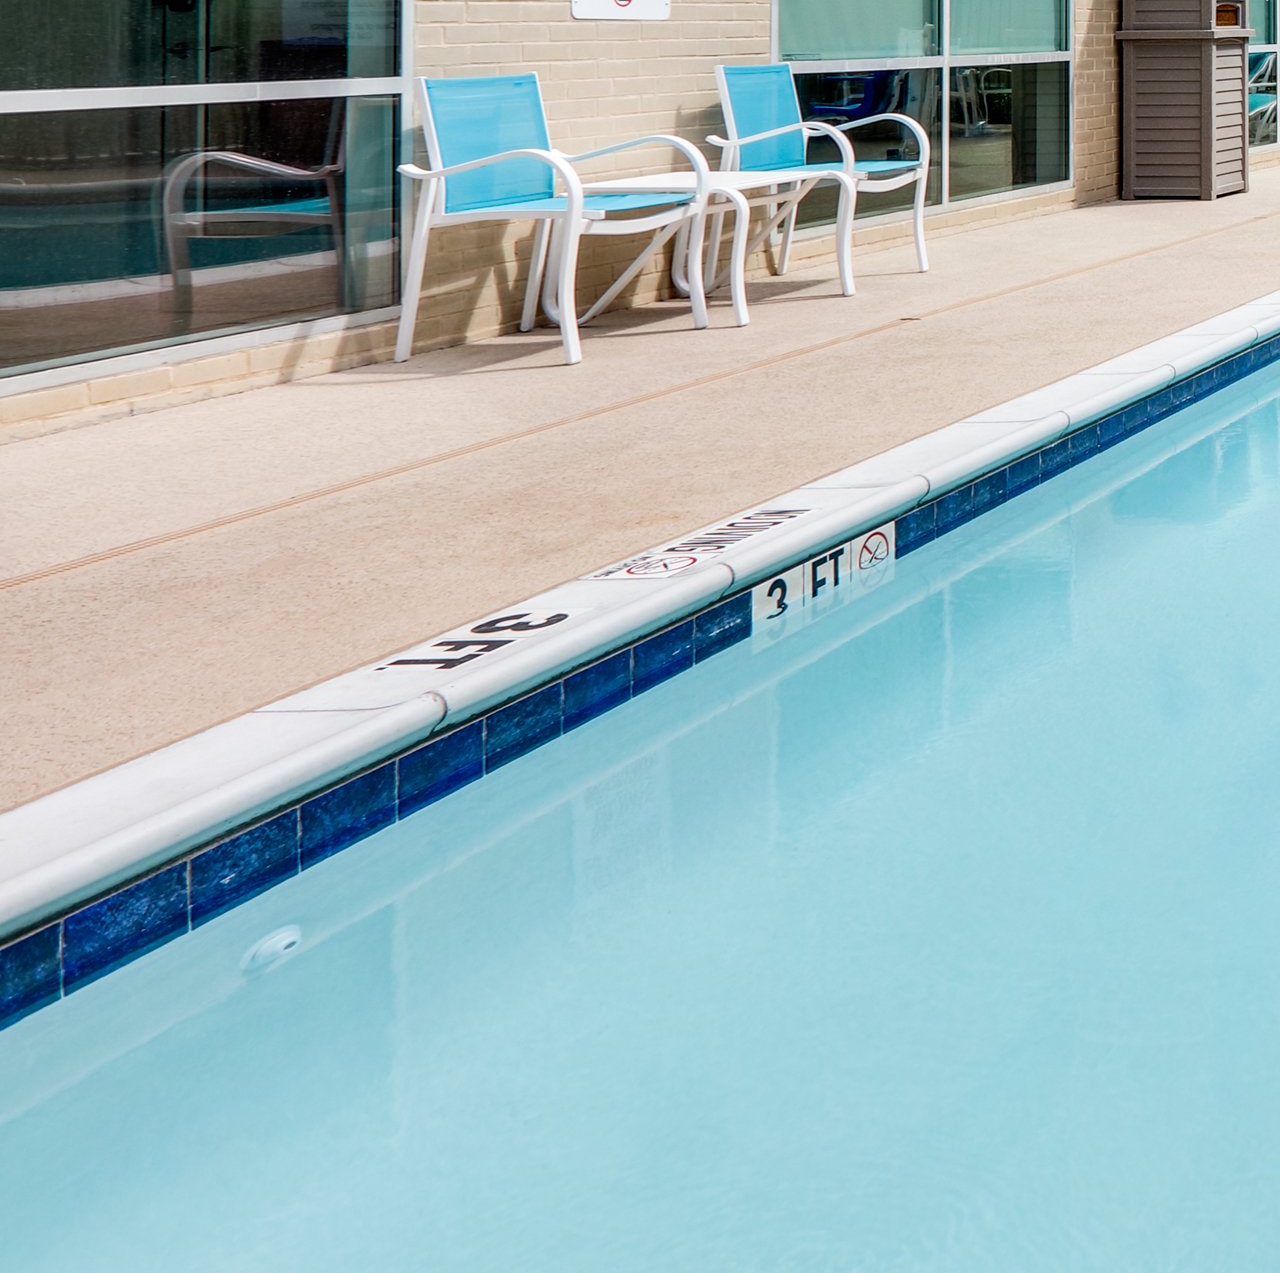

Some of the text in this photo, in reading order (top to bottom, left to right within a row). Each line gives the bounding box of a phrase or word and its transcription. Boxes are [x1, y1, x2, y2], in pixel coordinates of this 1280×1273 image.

[766, 547, 844, 619] 3 FT
[470, 613, 569, 634] 3
